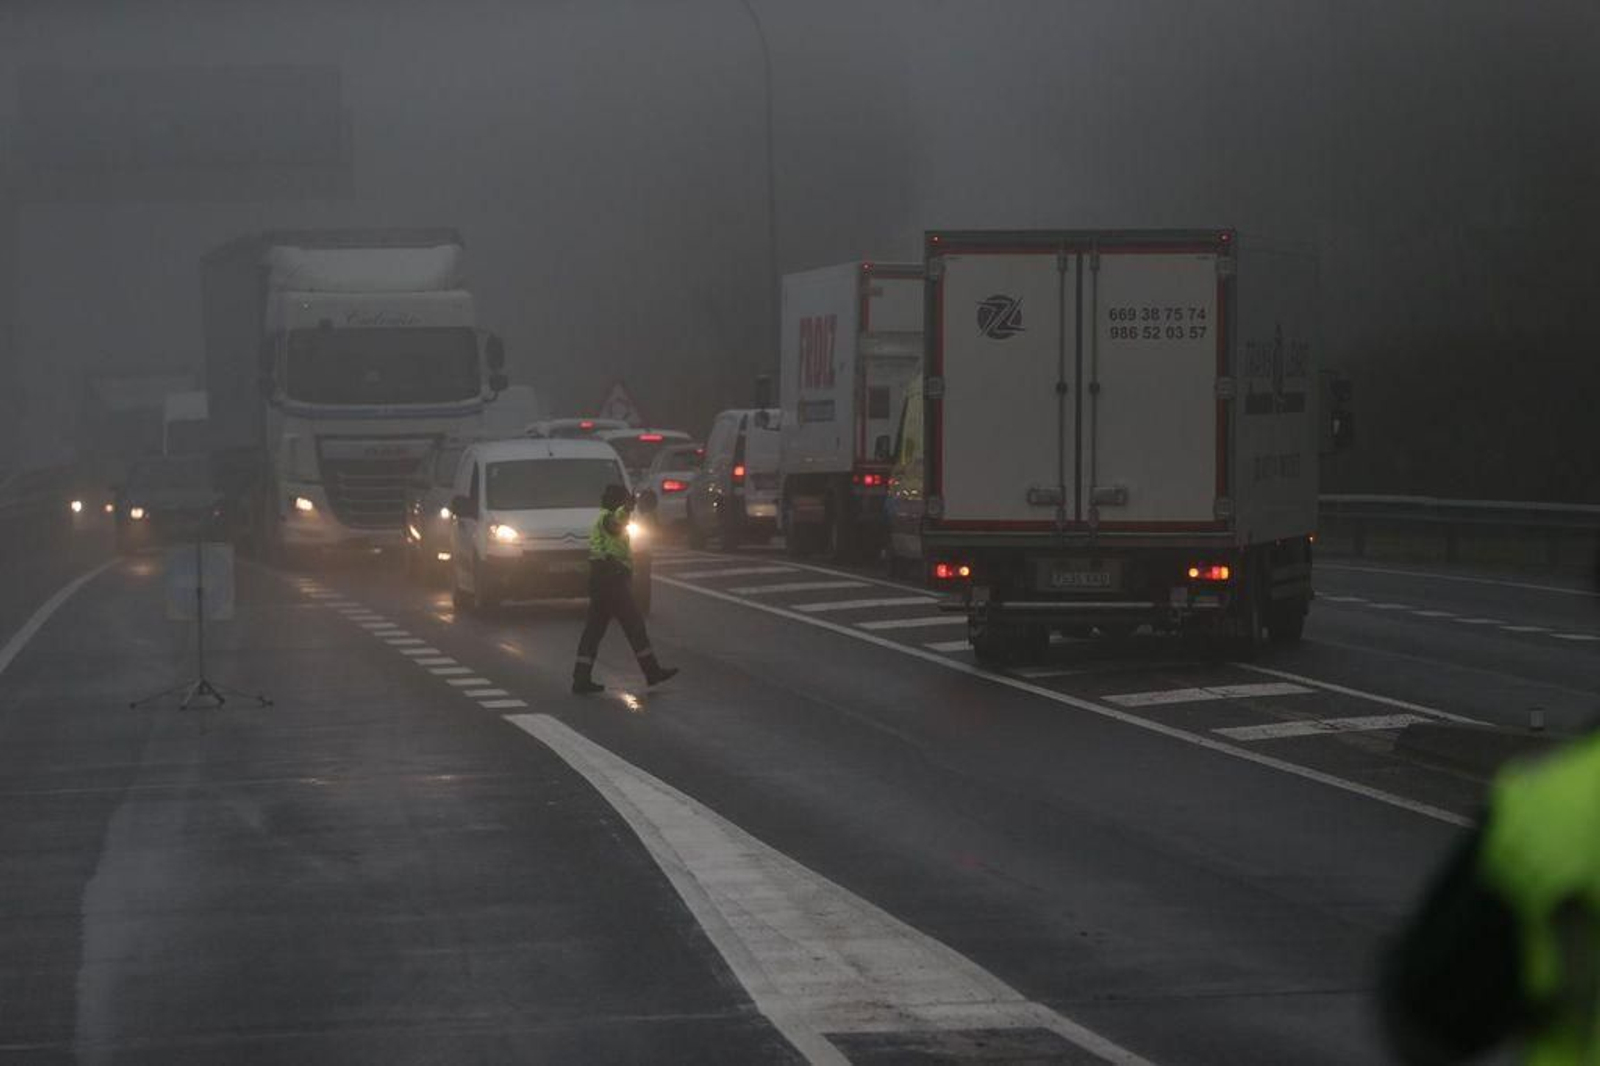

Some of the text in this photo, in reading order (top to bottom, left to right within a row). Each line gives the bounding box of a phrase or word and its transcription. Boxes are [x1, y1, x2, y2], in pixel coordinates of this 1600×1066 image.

[1109, 307, 1206, 321] 669 38 75 74
[1110, 326, 1207, 340] 986 52 03 57
